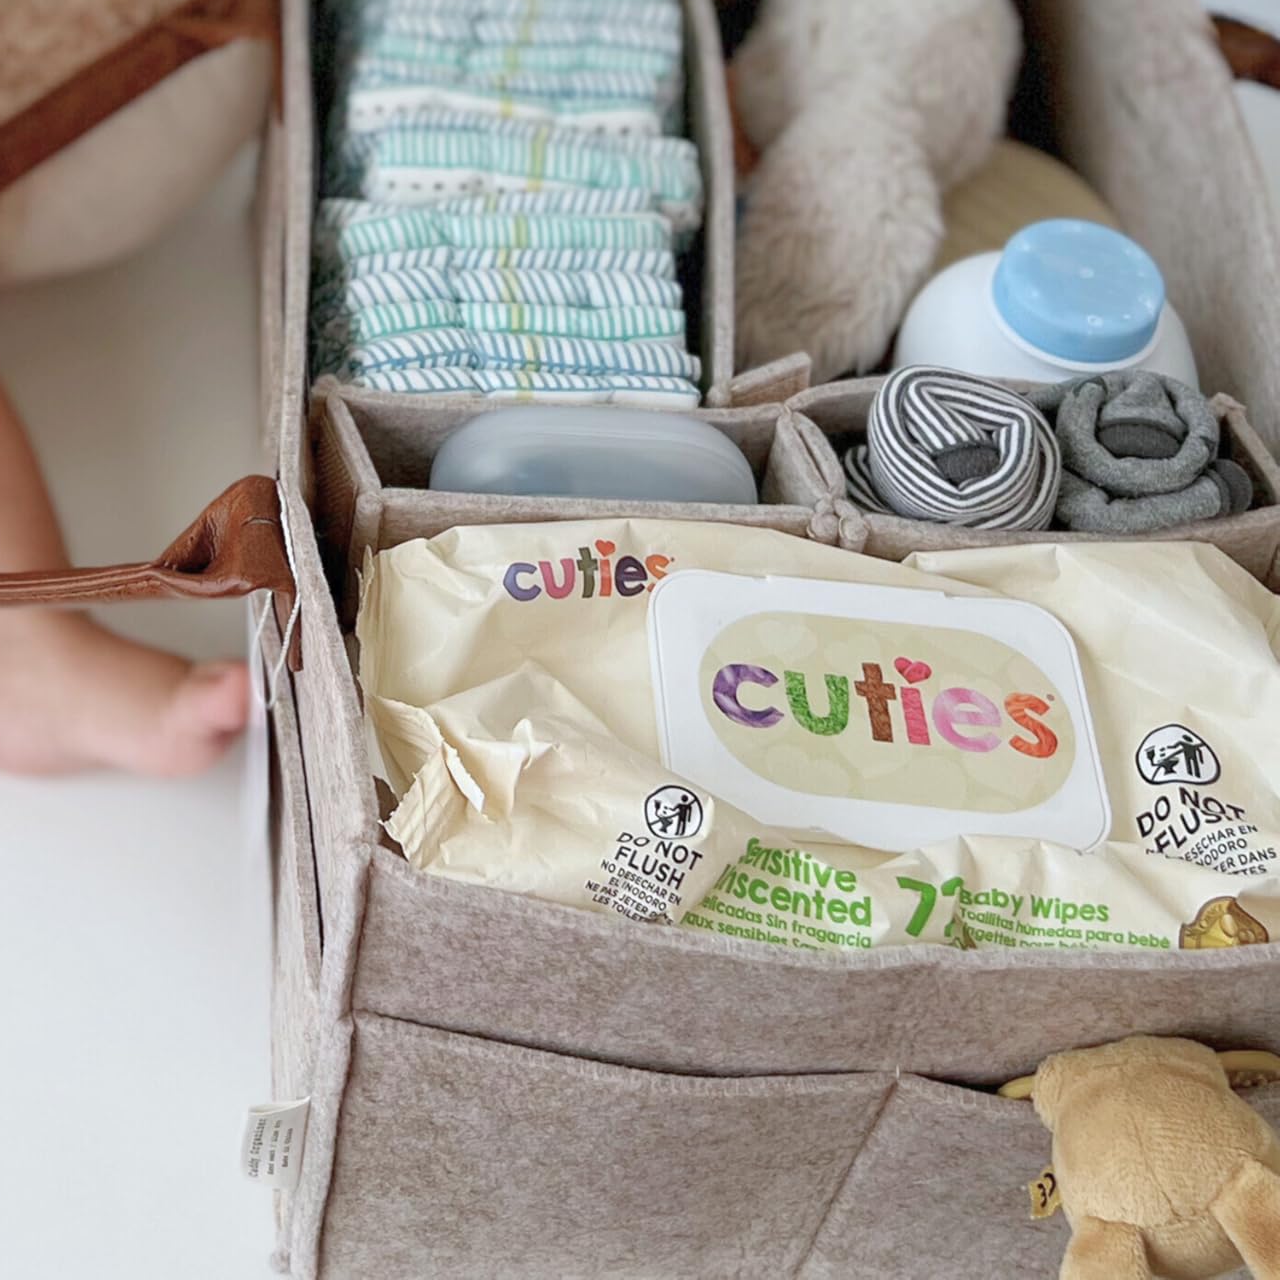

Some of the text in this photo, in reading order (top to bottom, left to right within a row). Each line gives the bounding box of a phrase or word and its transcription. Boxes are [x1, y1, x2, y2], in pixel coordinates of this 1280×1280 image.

[713, 656, 1059, 758] cuties
[1136, 786, 1246, 838] DO NOT
[1154, 807, 1233, 854] FLUS
[1183, 825, 1258, 862] ESECHAR EN
[614, 846, 685, 890] FLUSH
[616, 832, 703, 870] DO NOT
[1238, 847, 1277, 866] DANS
[585, 880, 648, 915] NE PAS JETER
[592, 894, 609, 905] LES
[600, 859, 682, 906] NO DESECHAR EN
[608, 876, 667, 911] EL INODORO
[960, 888, 1109, 924] Baby Wipes
[766, 913, 787, 930] Sin
[792, 919, 871, 949] fragancia
[1086, 929, 1124, 943] para
